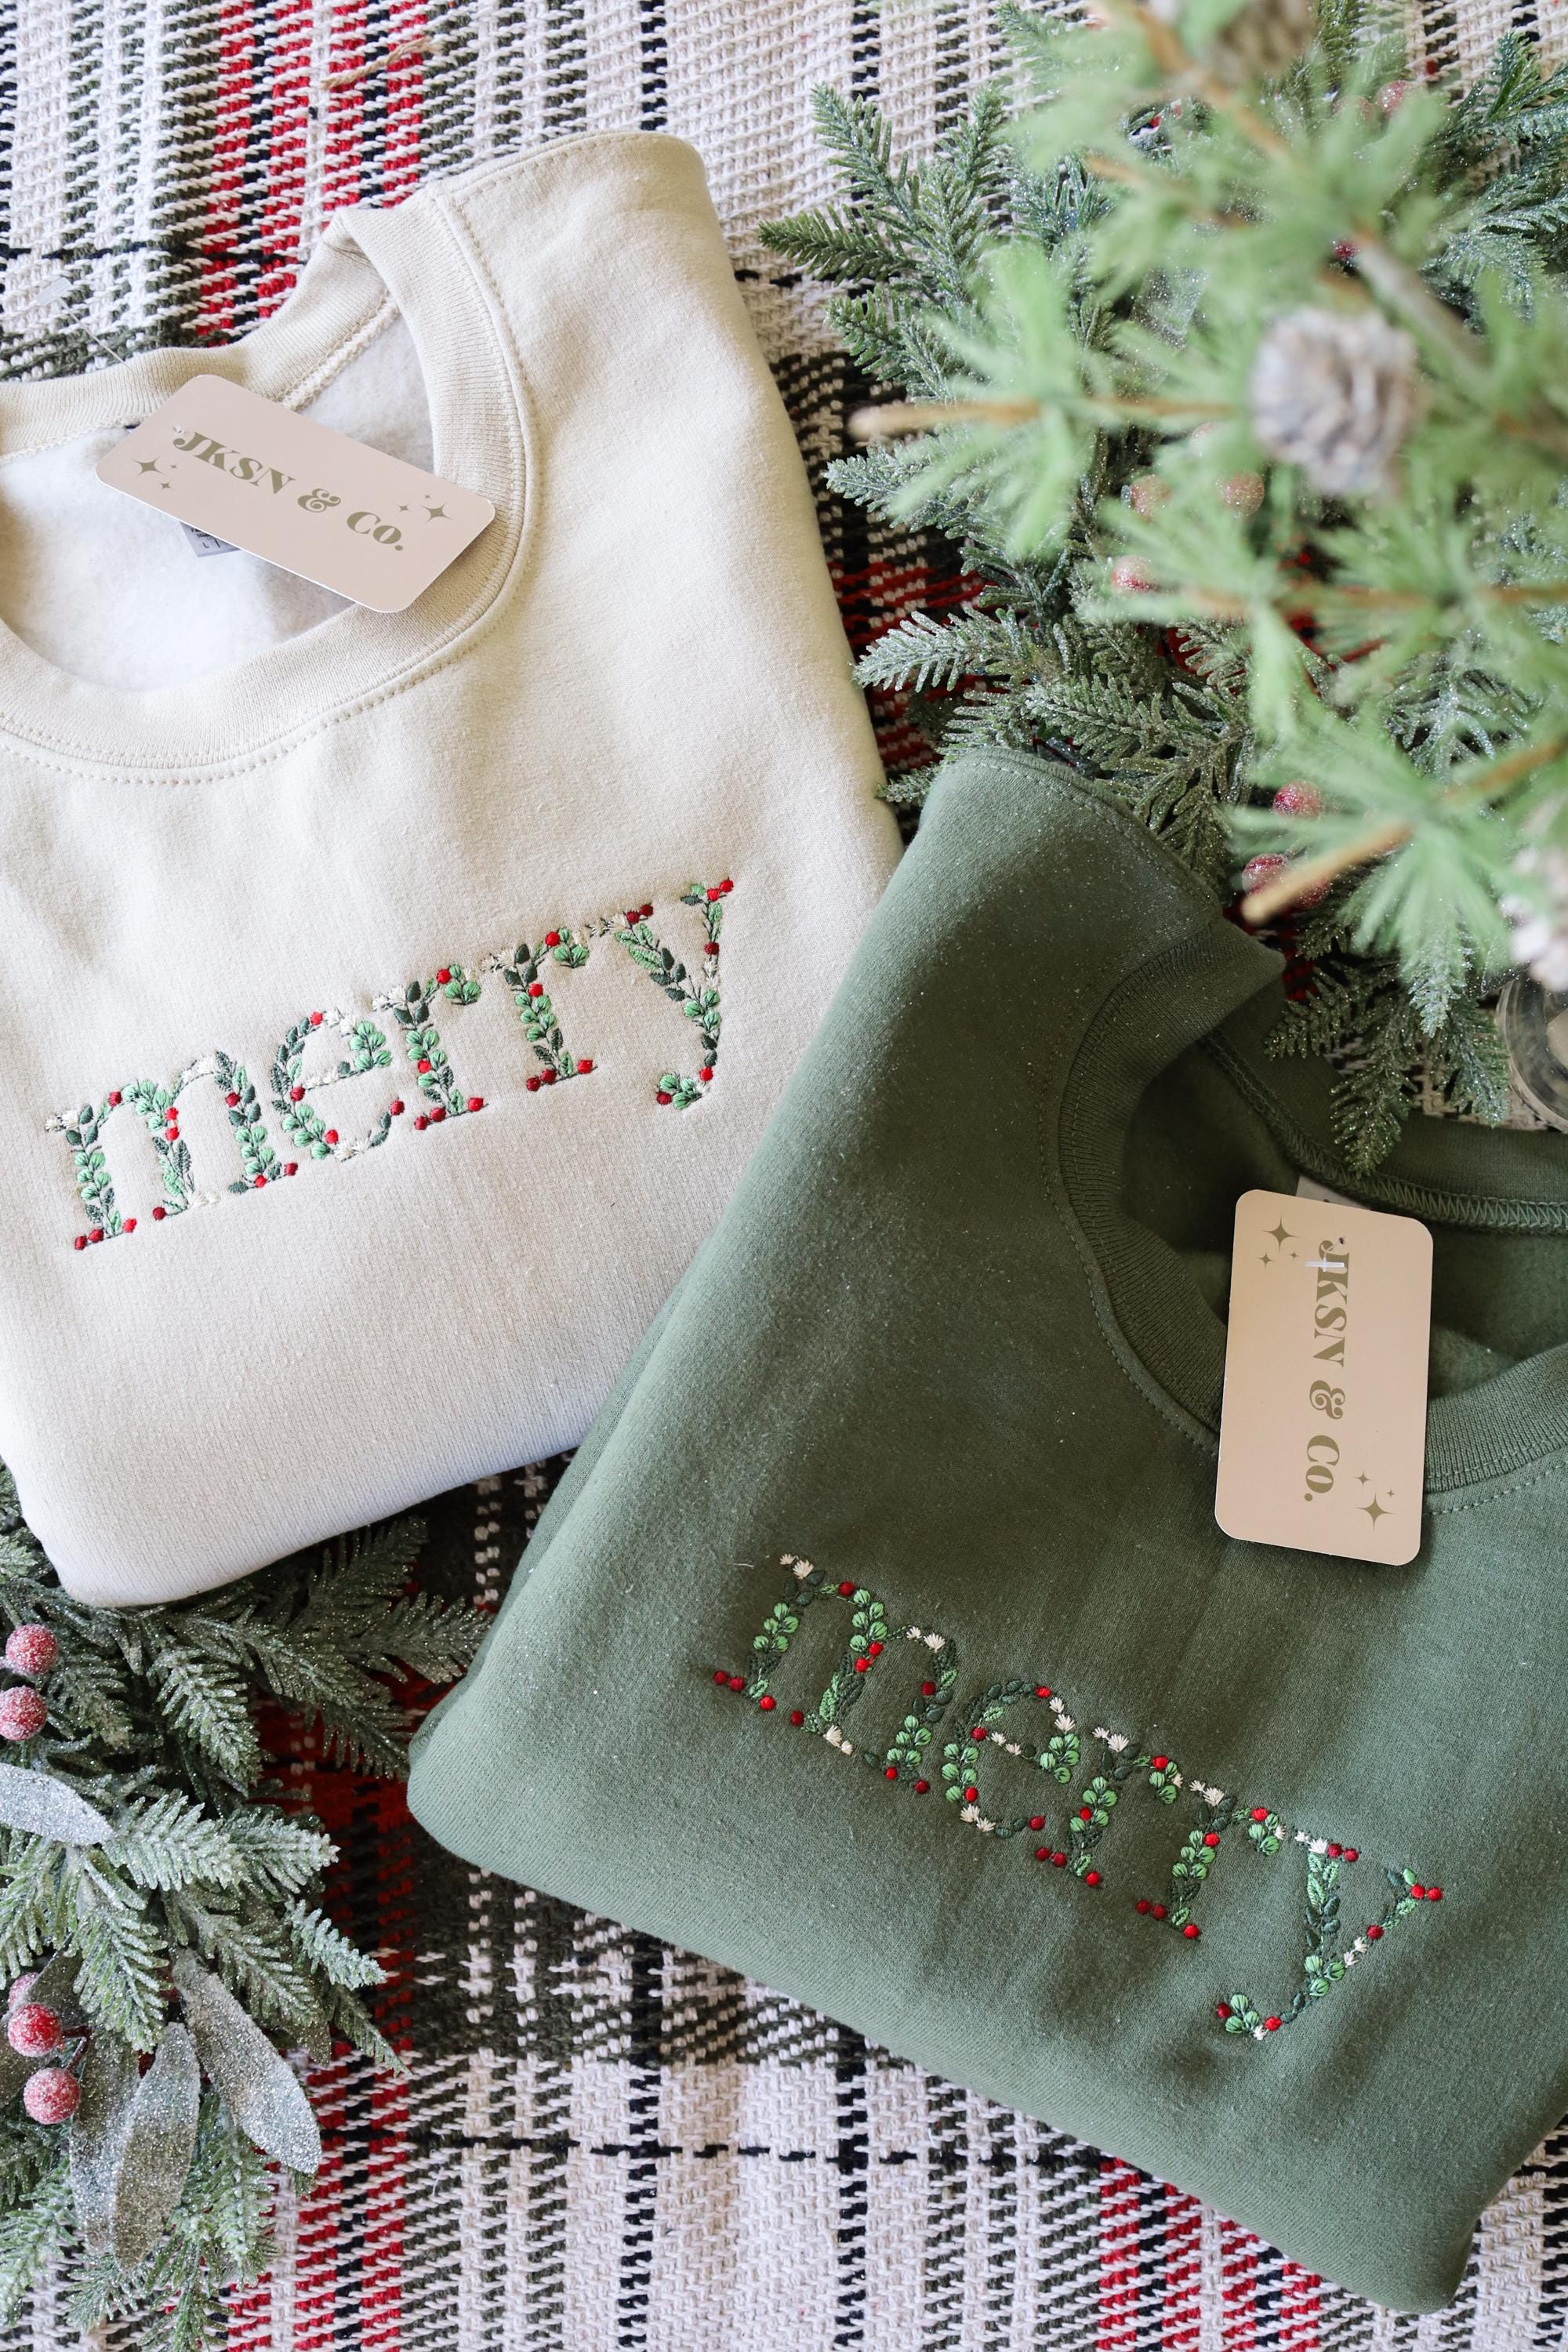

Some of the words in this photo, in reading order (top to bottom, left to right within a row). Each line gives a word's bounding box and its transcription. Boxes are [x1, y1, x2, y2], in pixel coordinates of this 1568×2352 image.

[172, 431, 296, 494] JKSN
[297, 488, 341, 513] &
[45, 877, 734, 1250] merry
[1313, 1240, 1350, 1368] JKSN
[1309, 1380, 1345, 1420] &
[712, 1552, 1443, 2040] merry
